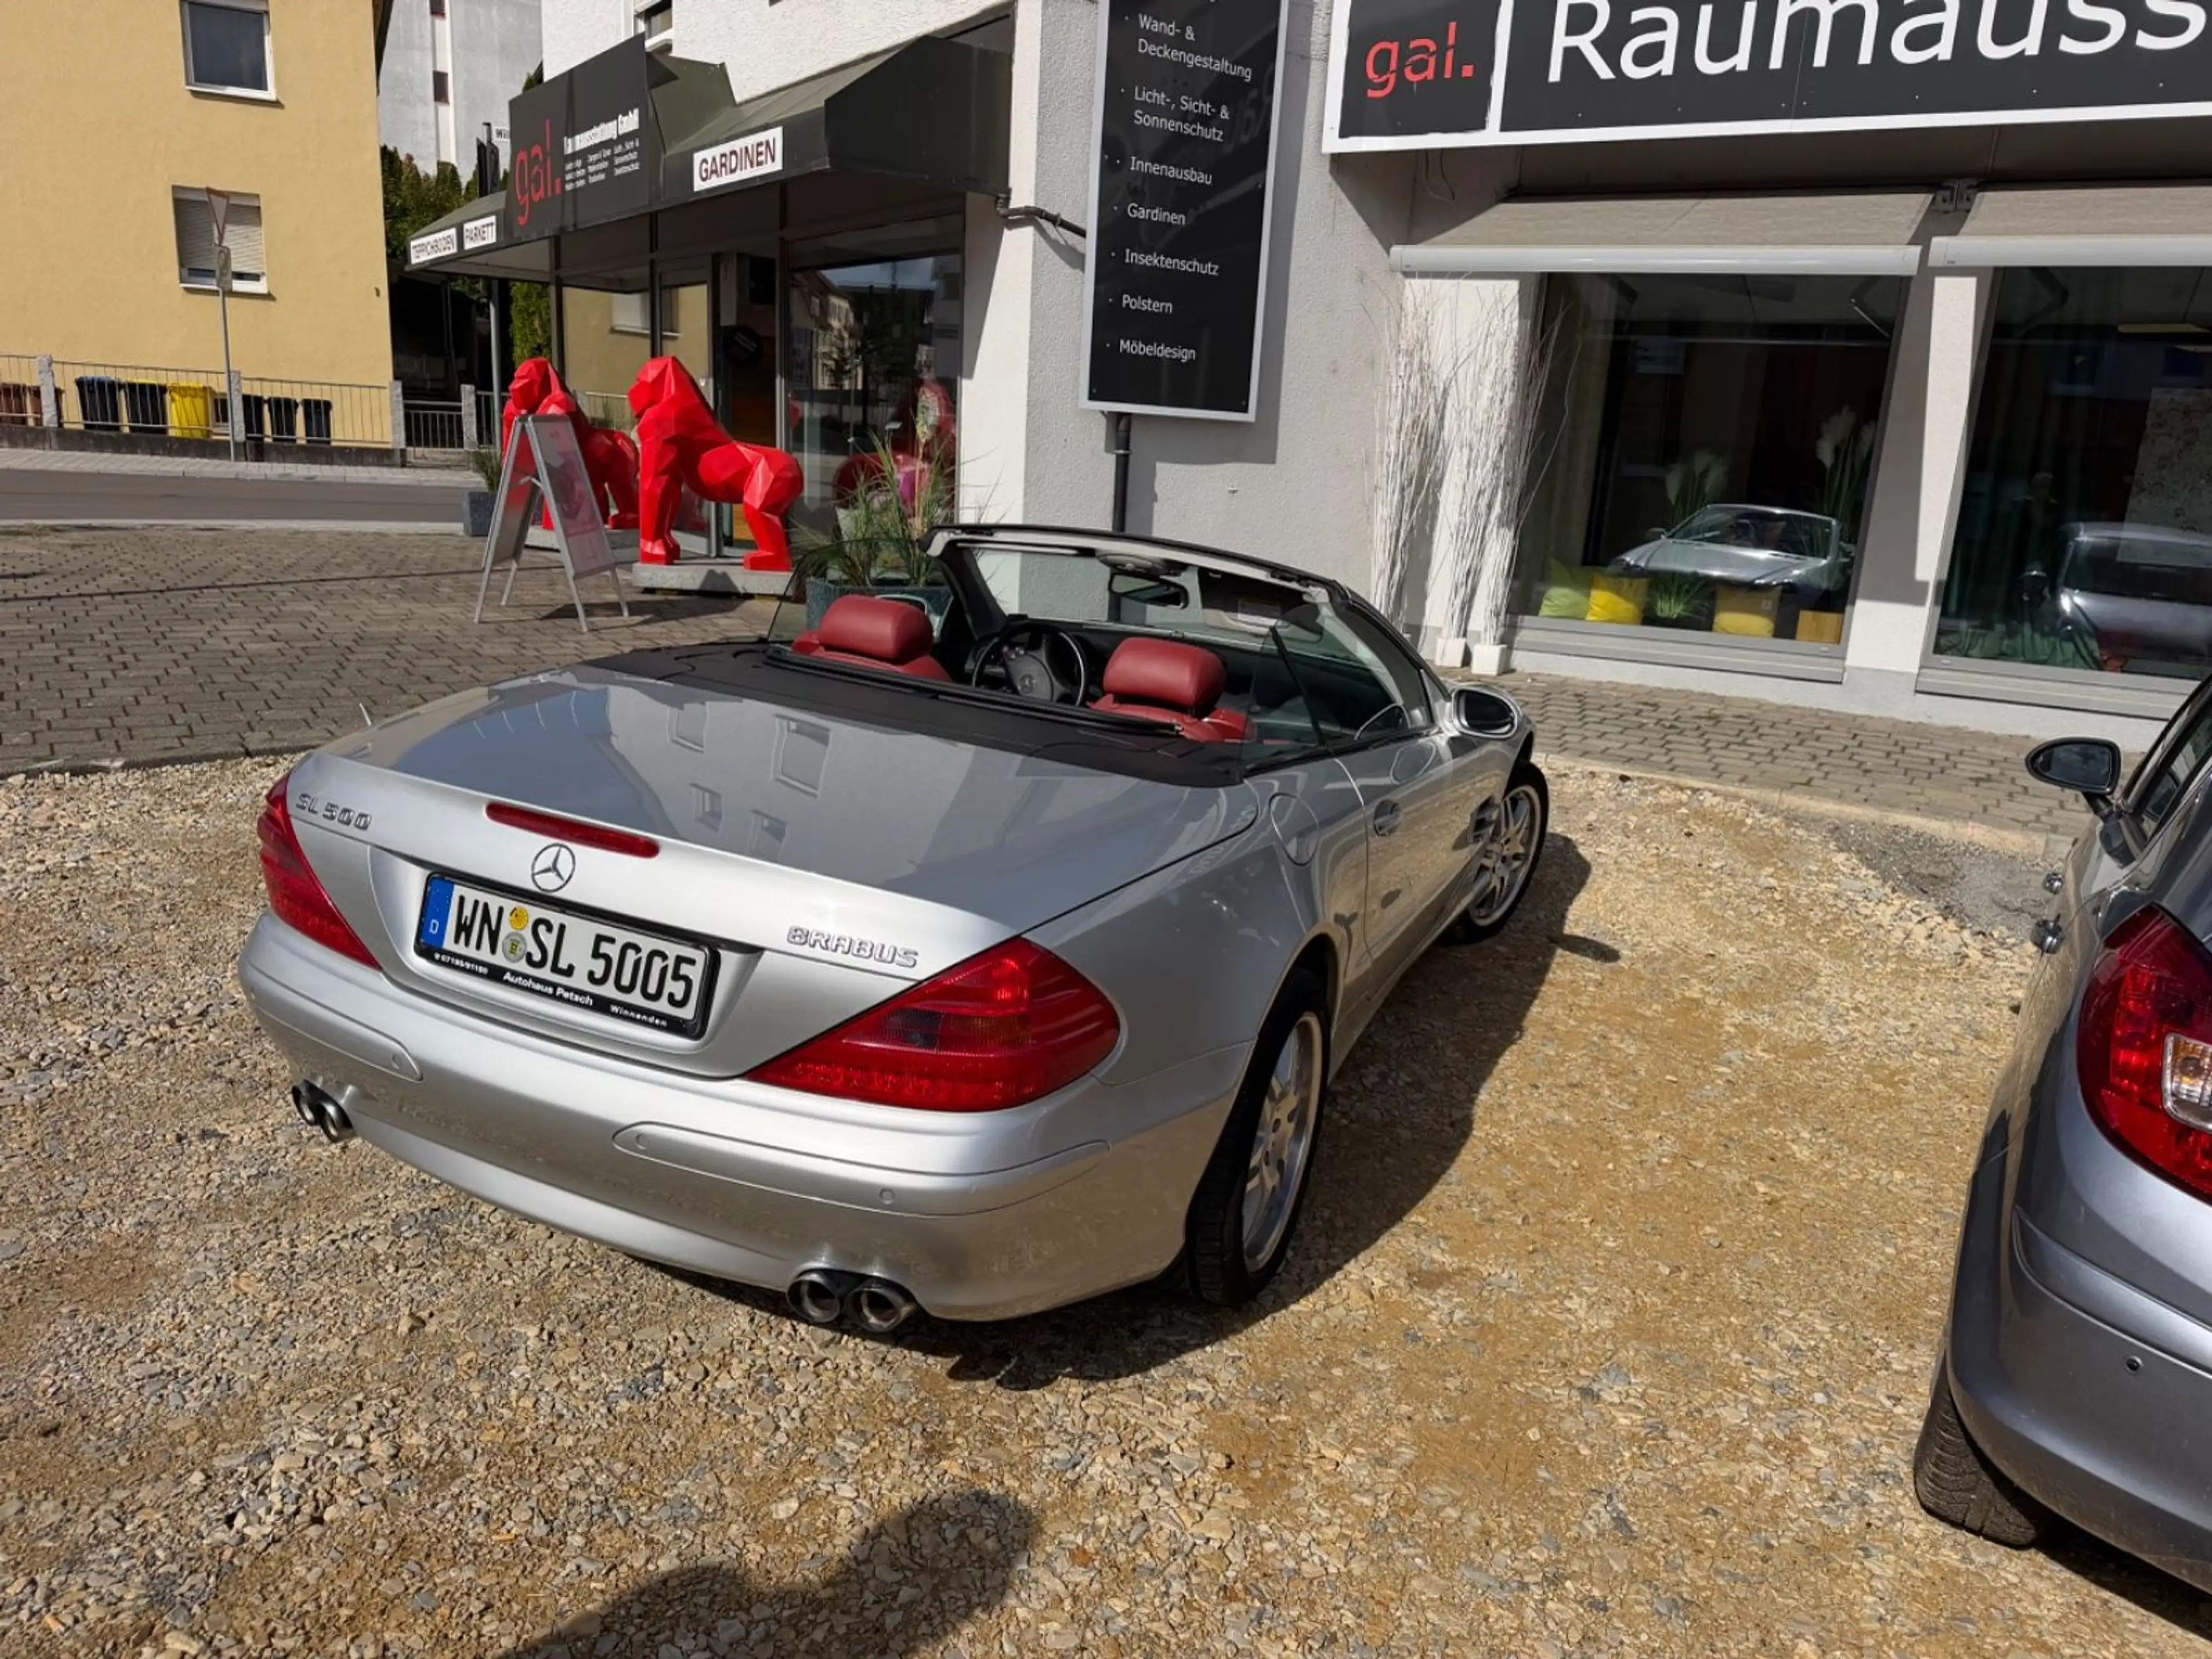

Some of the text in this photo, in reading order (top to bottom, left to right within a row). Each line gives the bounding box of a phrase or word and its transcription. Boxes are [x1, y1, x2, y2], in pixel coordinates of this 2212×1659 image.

[1138, 13, 1196, 41] Wand- &
[1138, 38, 1252, 82] Deckengestaltung
[1365, 21, 1475, 98] gal.
[1134, 85, 1230, 120] Licht-, Sicht- &
[1133, 109, 1224, 142] Sonnenschutz
[515, 117, 563, 226] gal.
[699, 137, 776, 182] GARDINEN
[1130, 156, 1213, 186] Innenausbau
[1127, 203, 1187, 226] Gardinen
[1124, 248, 1219, 276] Insektenschutz
[1122, 294, 1173, 315] Polstern
[1119, 338, 1196, 362] Möbeldesign
[296, 793, 373, 831] SL 500
[429, 919, 439, 933] D
[453, 895, 697, 1008] WN SL 5005
[787, 925, 919, 968] BRABUS
[503, 972, 593, 1007] Autohaus Petsch
[609, 1004, 667, 1027] Winnenden
